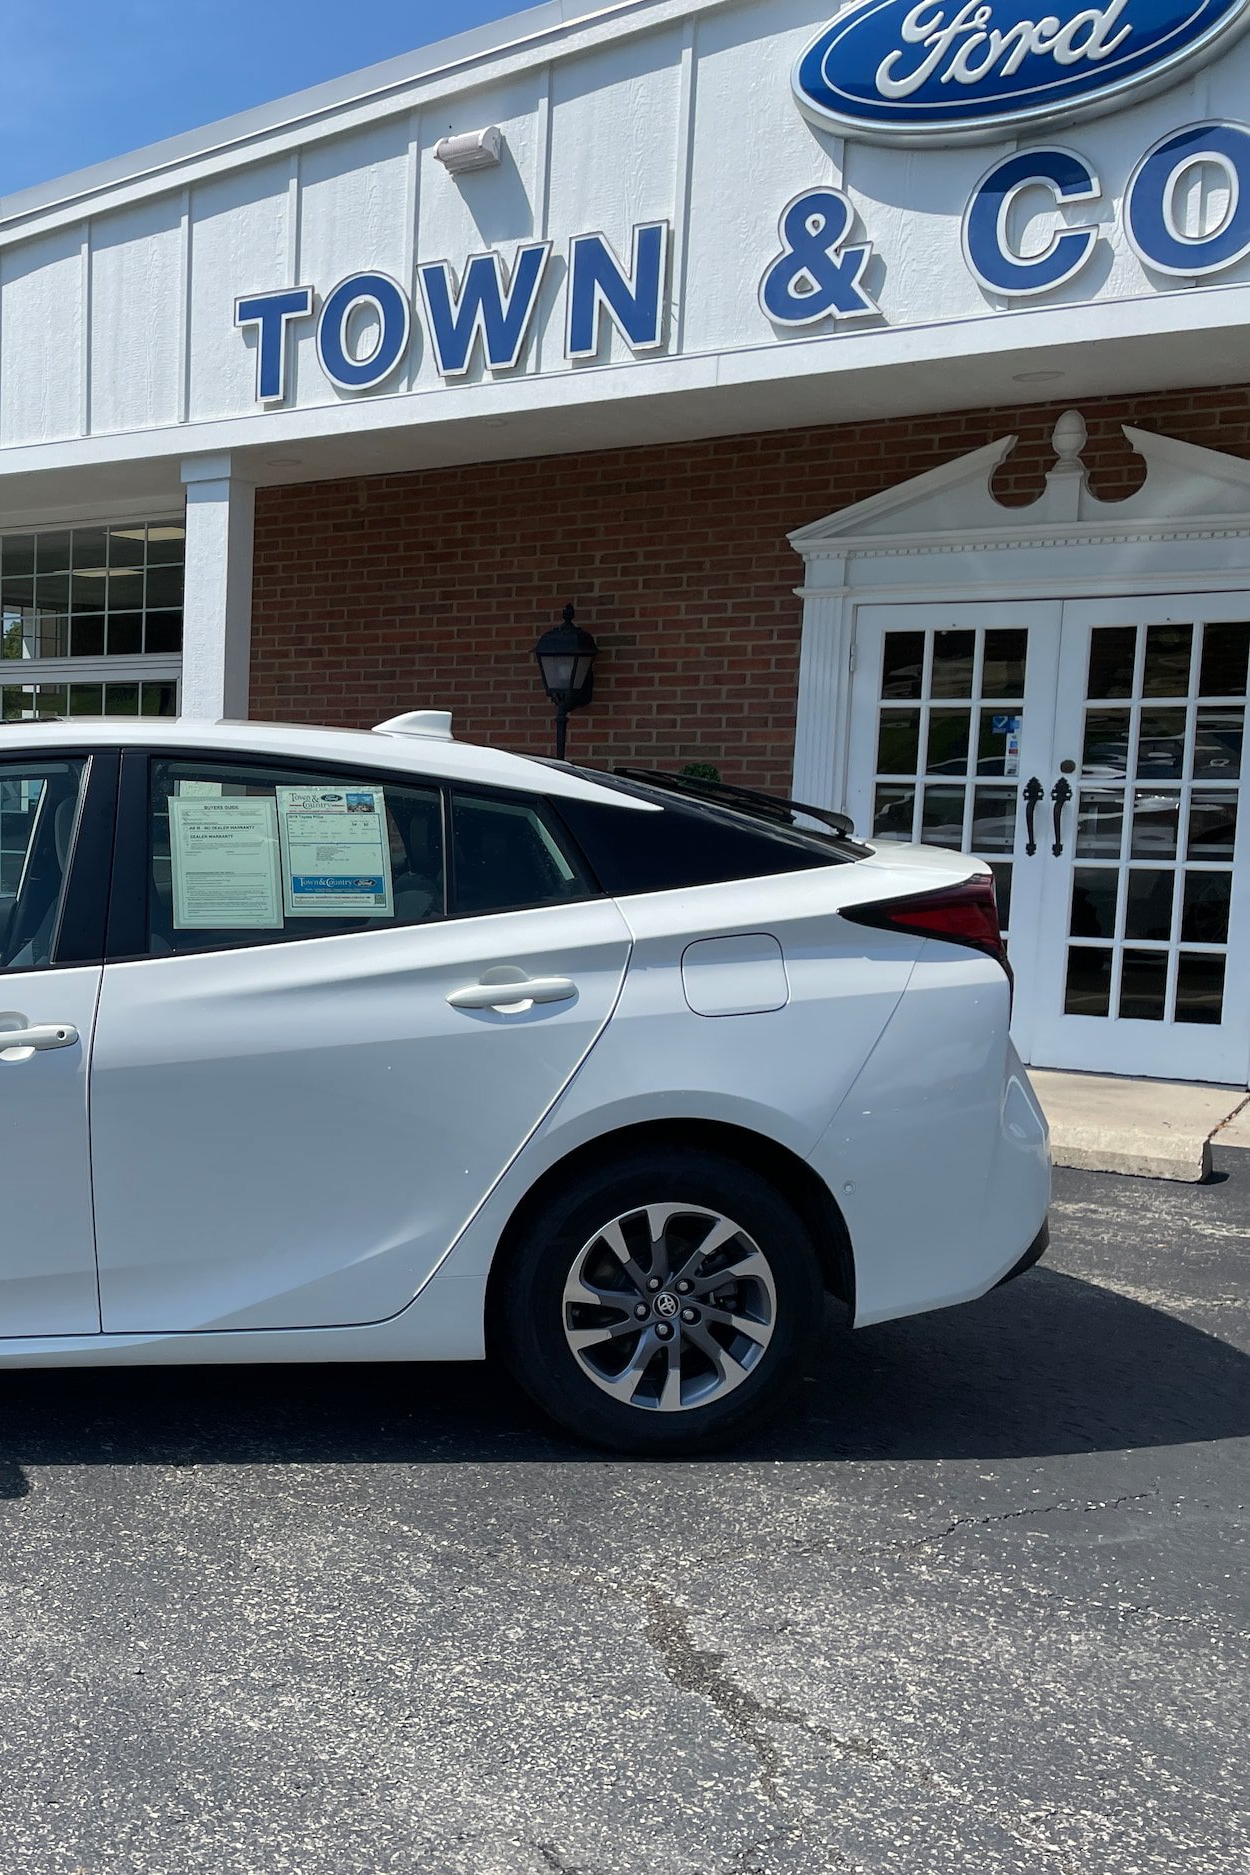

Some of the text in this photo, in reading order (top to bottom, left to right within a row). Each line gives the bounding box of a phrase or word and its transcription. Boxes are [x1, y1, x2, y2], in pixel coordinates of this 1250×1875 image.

[875, 0, 1134, 100] Ford
[234, 219, 670, 403] TOWN
[757, 185, 884, 327] &
[289, 793, 311, 802] Town
[302, 800, 332, 809] Country
